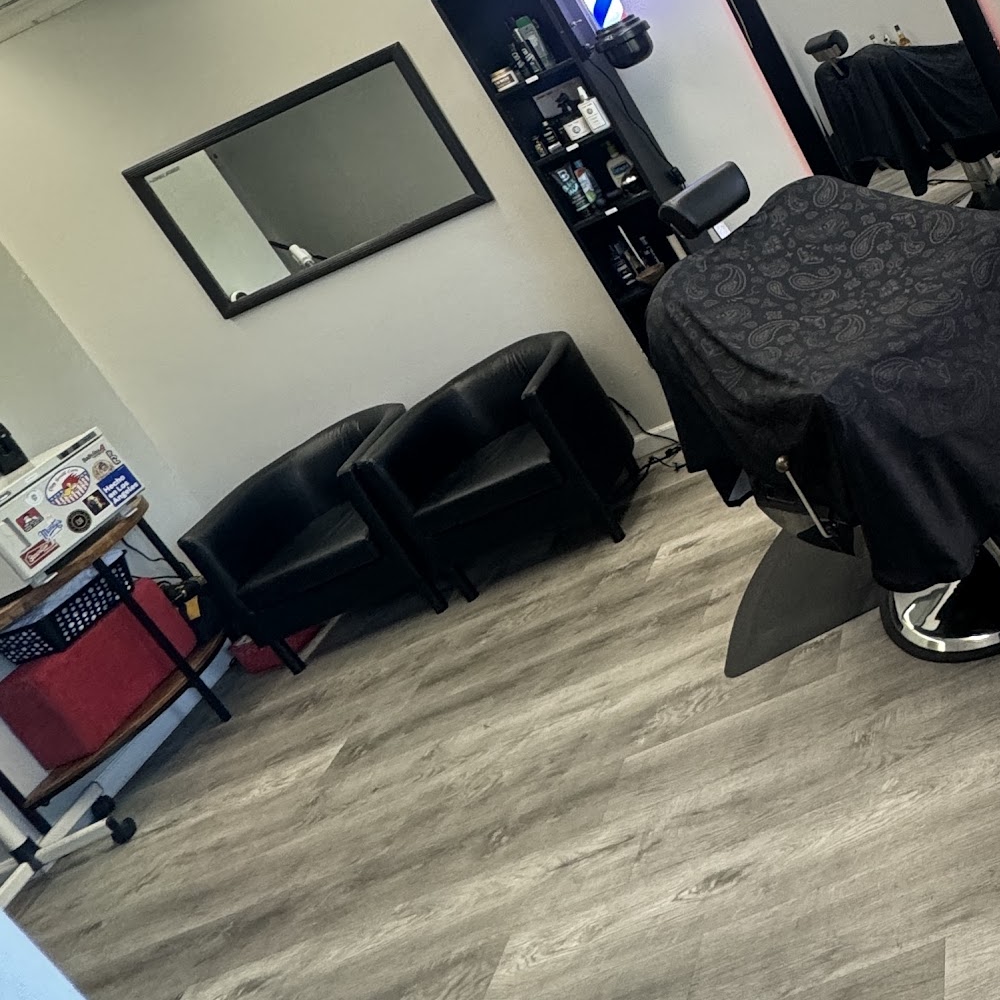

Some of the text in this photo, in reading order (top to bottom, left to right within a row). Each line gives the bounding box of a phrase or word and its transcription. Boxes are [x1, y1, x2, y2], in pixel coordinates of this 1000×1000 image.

[103, 474, 125, 493] Hecho
[108, 481, 129, 498] en Los
[112, 482, 139, 504] Angeles
